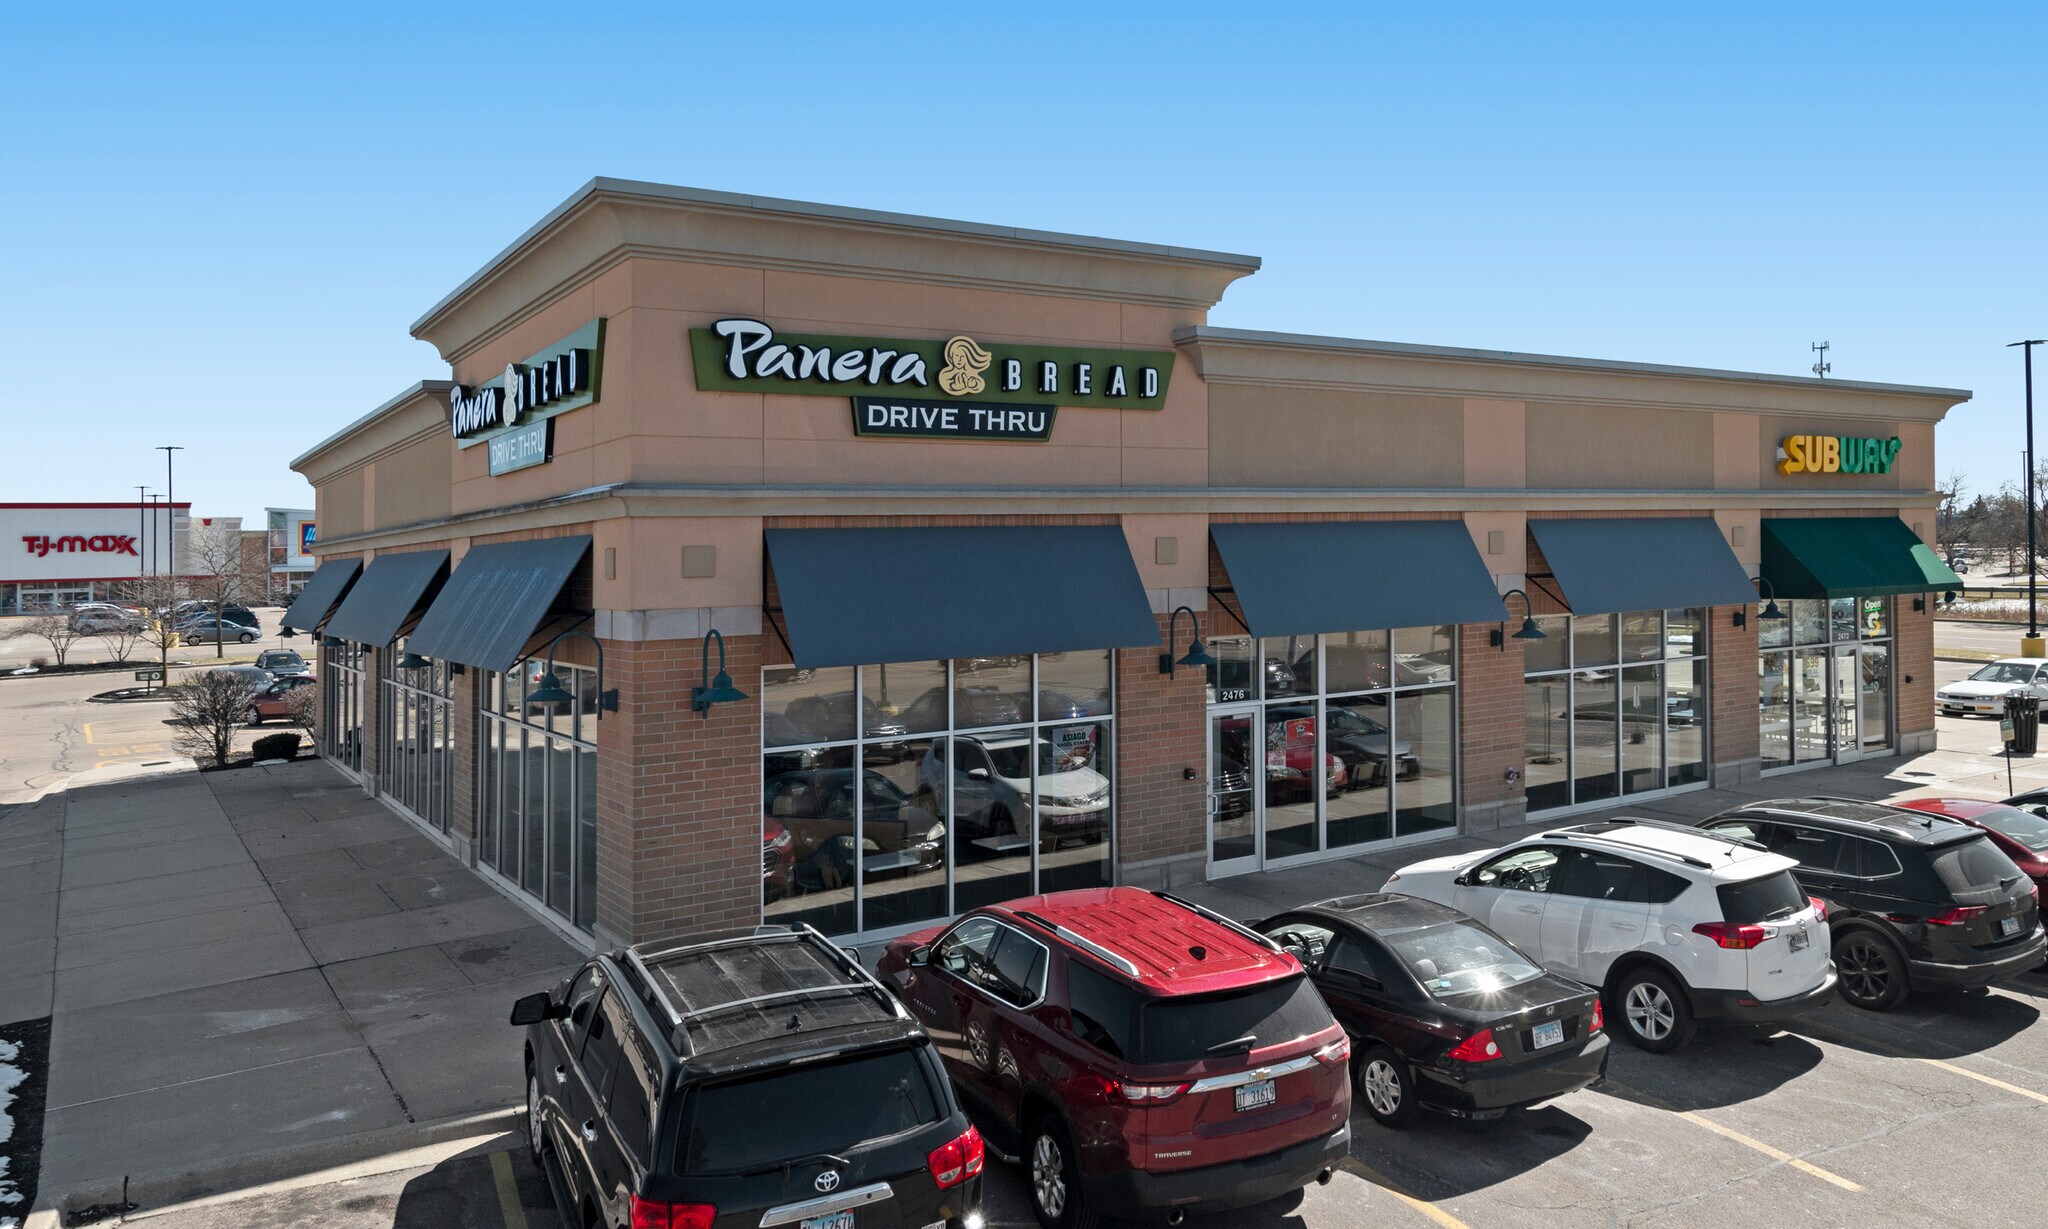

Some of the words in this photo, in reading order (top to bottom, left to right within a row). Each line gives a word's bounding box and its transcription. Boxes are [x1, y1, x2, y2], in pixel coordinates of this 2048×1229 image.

[715, 319, 928, 388] Panera
[1002, 358, 1159, 398] BREAD
[451, 385, 497, 439] Panera
[517, 348, 580, 413] BREAD
[867, 404, 959, 429] DRIVE
[969, 408, 1046, 432] THRU
[492, 440, 517, 466] DRIVE
[518, 429, 545, 457] THRU
[1779, 435, 1902, 474] SUBWAY
[1864, 600, 1882, 611] Open
[1222, 690, 1245, 700] 2476
[1062, 731, 1086, 742] ASIAGO
[1250, 1086, 1275, 1104] 31619
[1154, 1150, 1192, 1159] TRAVERSE
